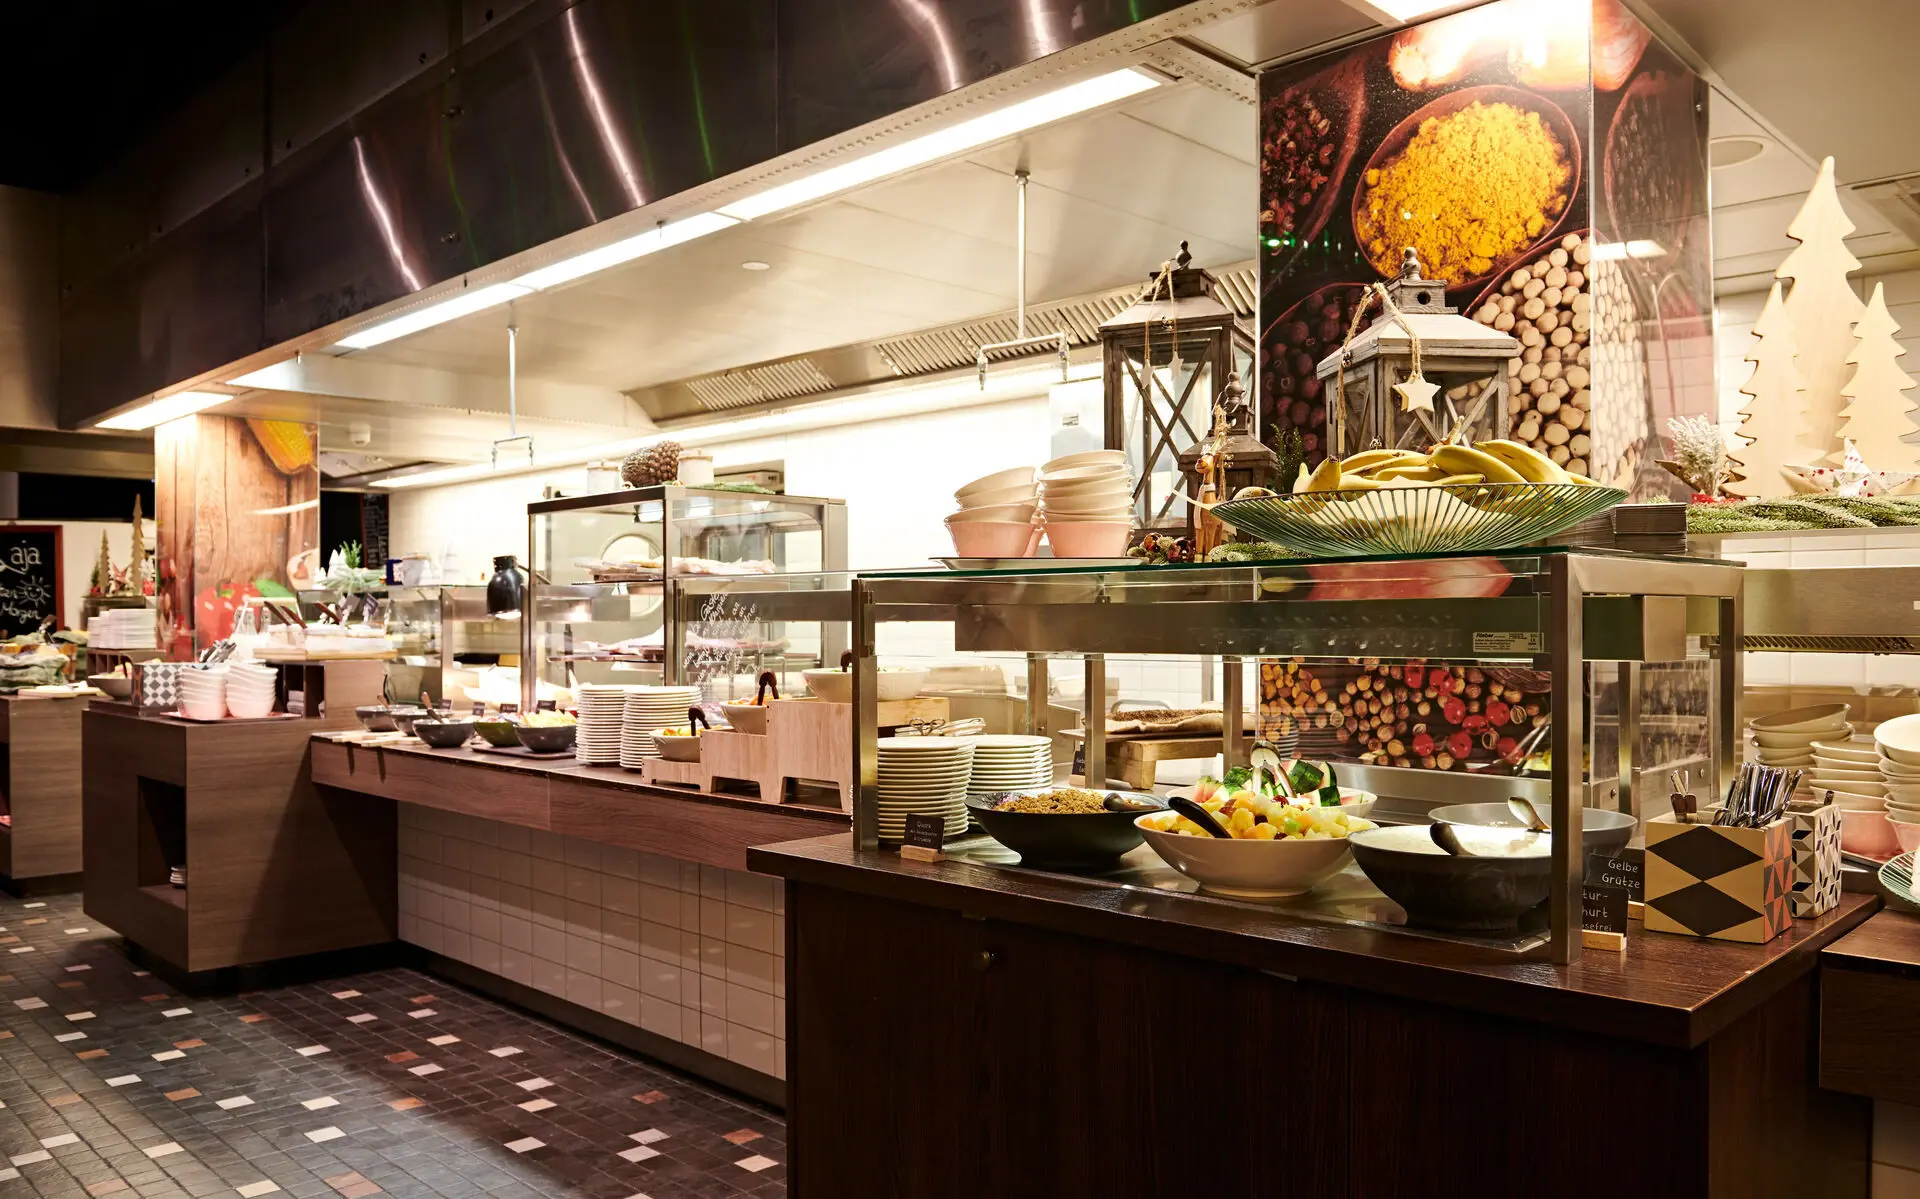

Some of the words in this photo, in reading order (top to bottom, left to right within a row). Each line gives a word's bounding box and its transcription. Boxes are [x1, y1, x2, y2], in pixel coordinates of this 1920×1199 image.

[9, 540, 42, 571] aja
[1608, 859, 1638, 873] Gelbe
[1602, 873, 1640, 889] Grütze
[1582, 888, 1609, 901] tur-
[1582, 906, 1608, 918] hurt
